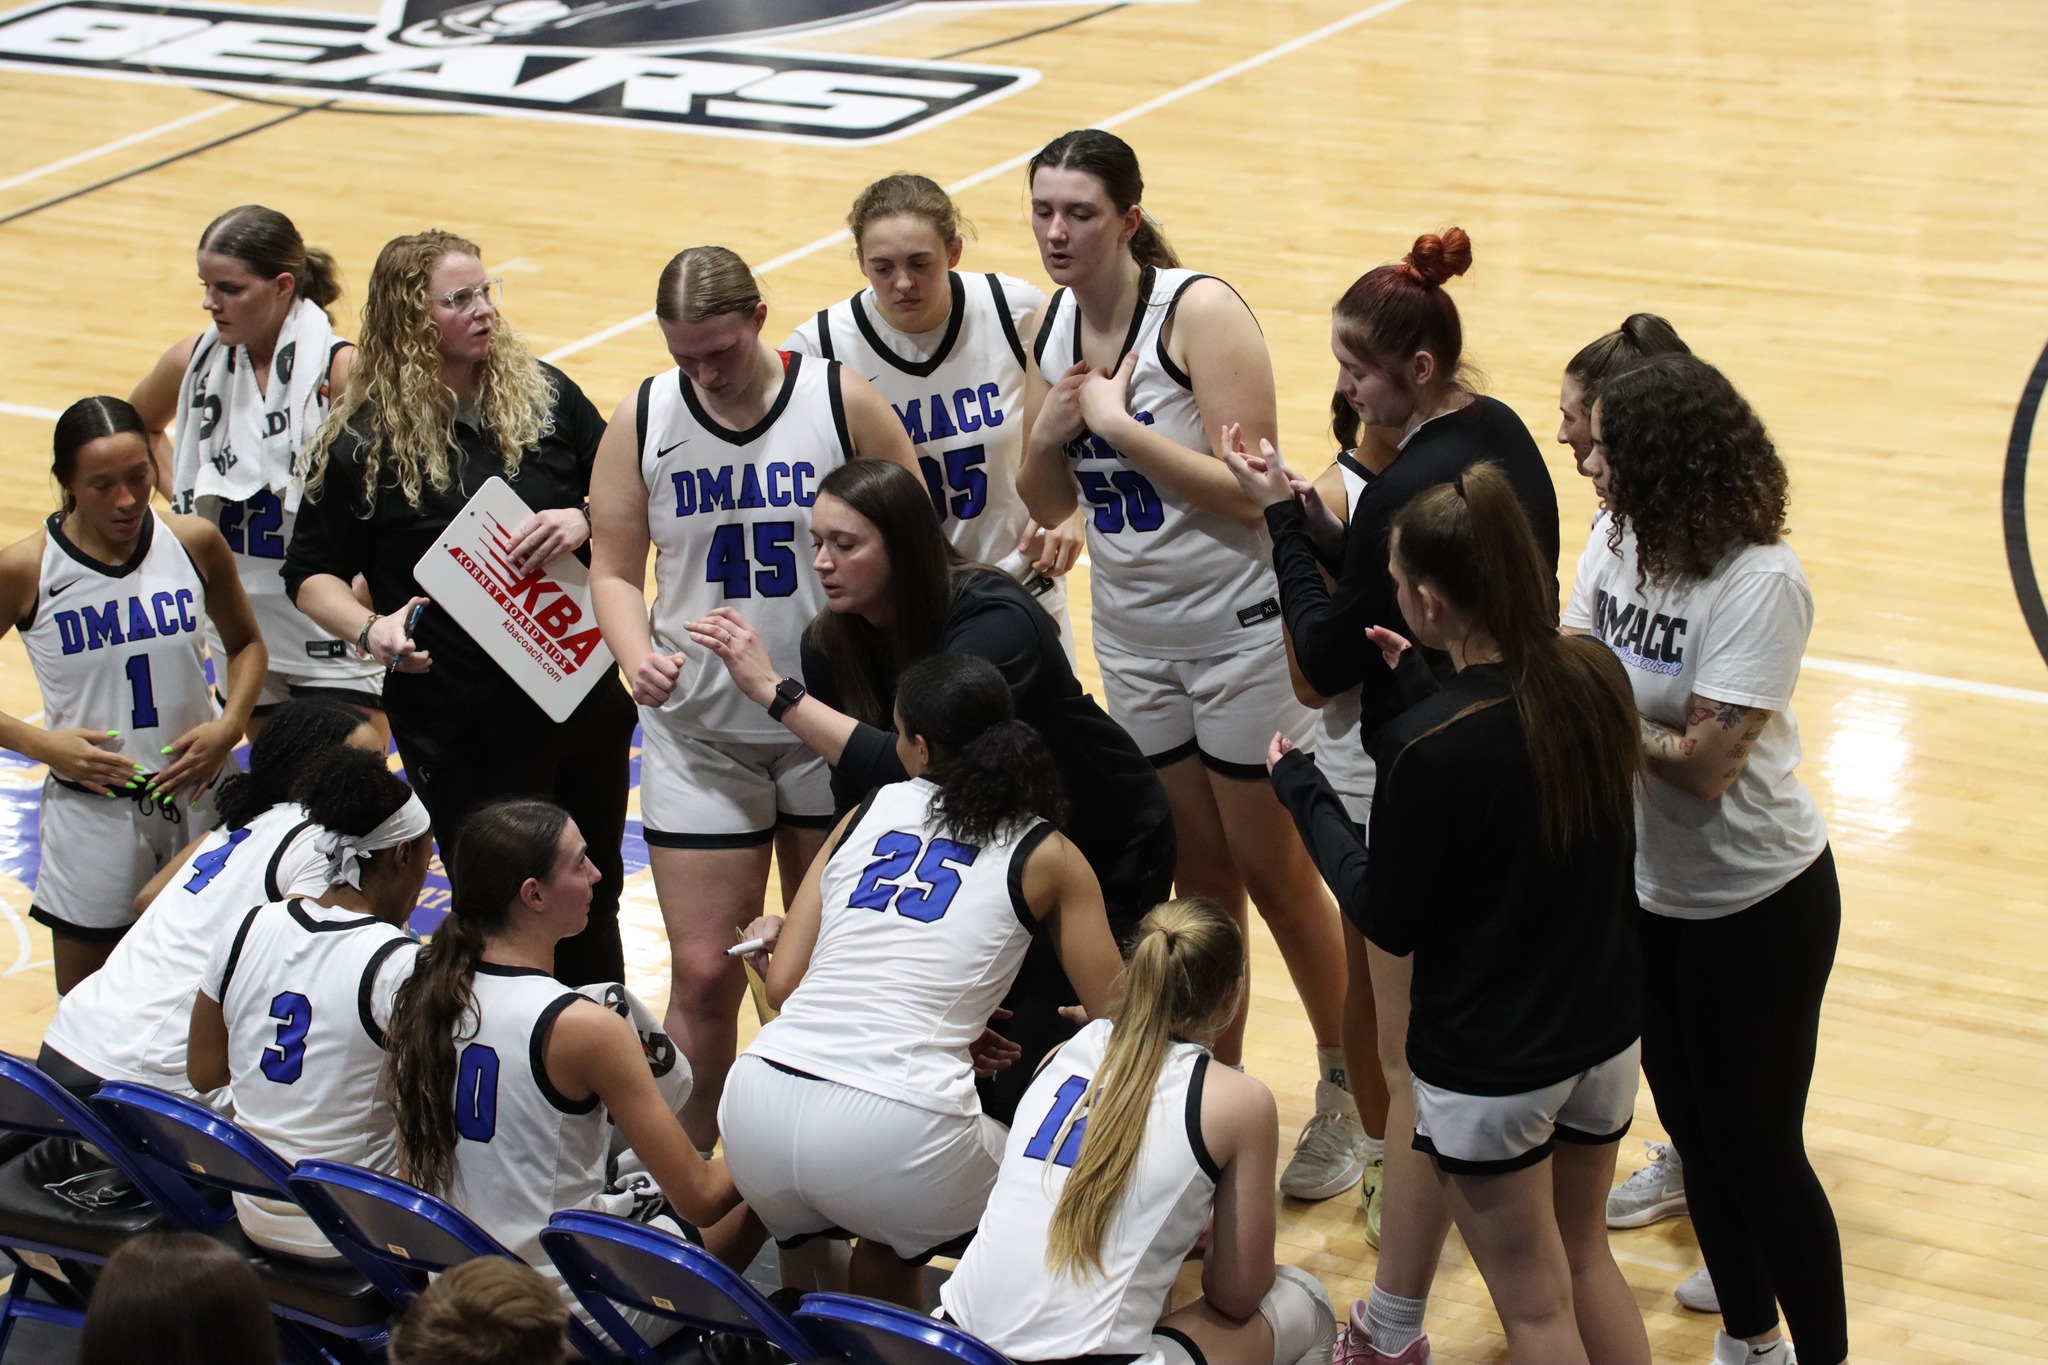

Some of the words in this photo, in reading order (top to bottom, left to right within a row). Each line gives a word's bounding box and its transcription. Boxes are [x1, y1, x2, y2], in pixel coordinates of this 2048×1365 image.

[0, 6, 978, 130] BEARS
[890, 381, 1004, 445] MACC
[219, 489, 284, 560] 22
[671, 461, 816, 517] DMACC
[1073, 470, 1165, 534] 50
[706, 521, 798, 599] 45
[54, 588, 197, 655] DMACC
[456, 551, 501, 598] KORNEY
[502, 598, 541, 639] BOARD
[540, 640, 570, 670] AIDS
[1263, 604, 1276, 614] XL
[502, 619, 562, 683] kbacoach.com
[125, 653, 159, 730] 1
[183, 827, 253, 896] 4
[846, 829, 981, 924] 25
[260, 990, 312, 1085] 3
[455, 1042, 500, 1144] 0
